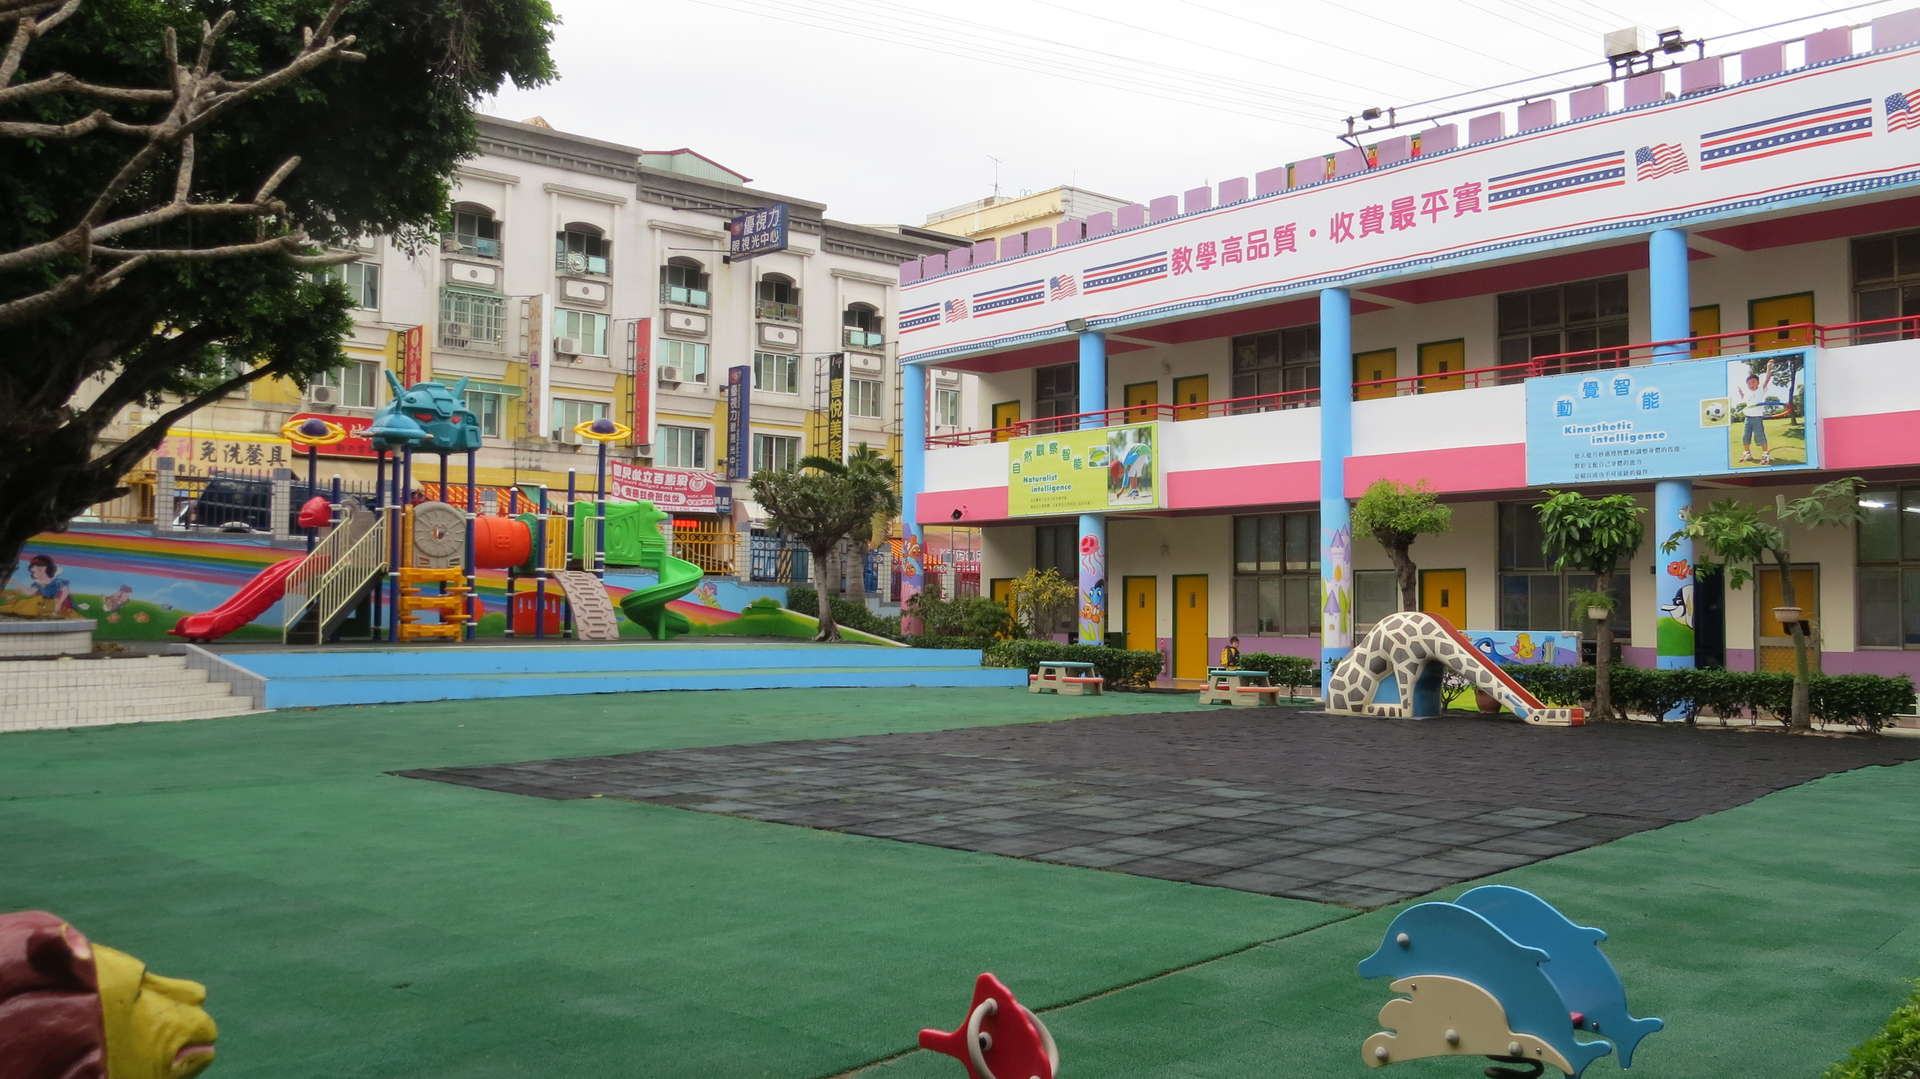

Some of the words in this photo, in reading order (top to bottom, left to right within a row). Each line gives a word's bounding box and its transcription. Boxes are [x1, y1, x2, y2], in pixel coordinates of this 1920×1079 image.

[744, 209, 779, 236] 優視力
[1556, 378, 1661, 417] 動覺智能
[1564, 421, 1633, 434] Kinesthetic
[1592, 431, 1666, 444] intelligence
